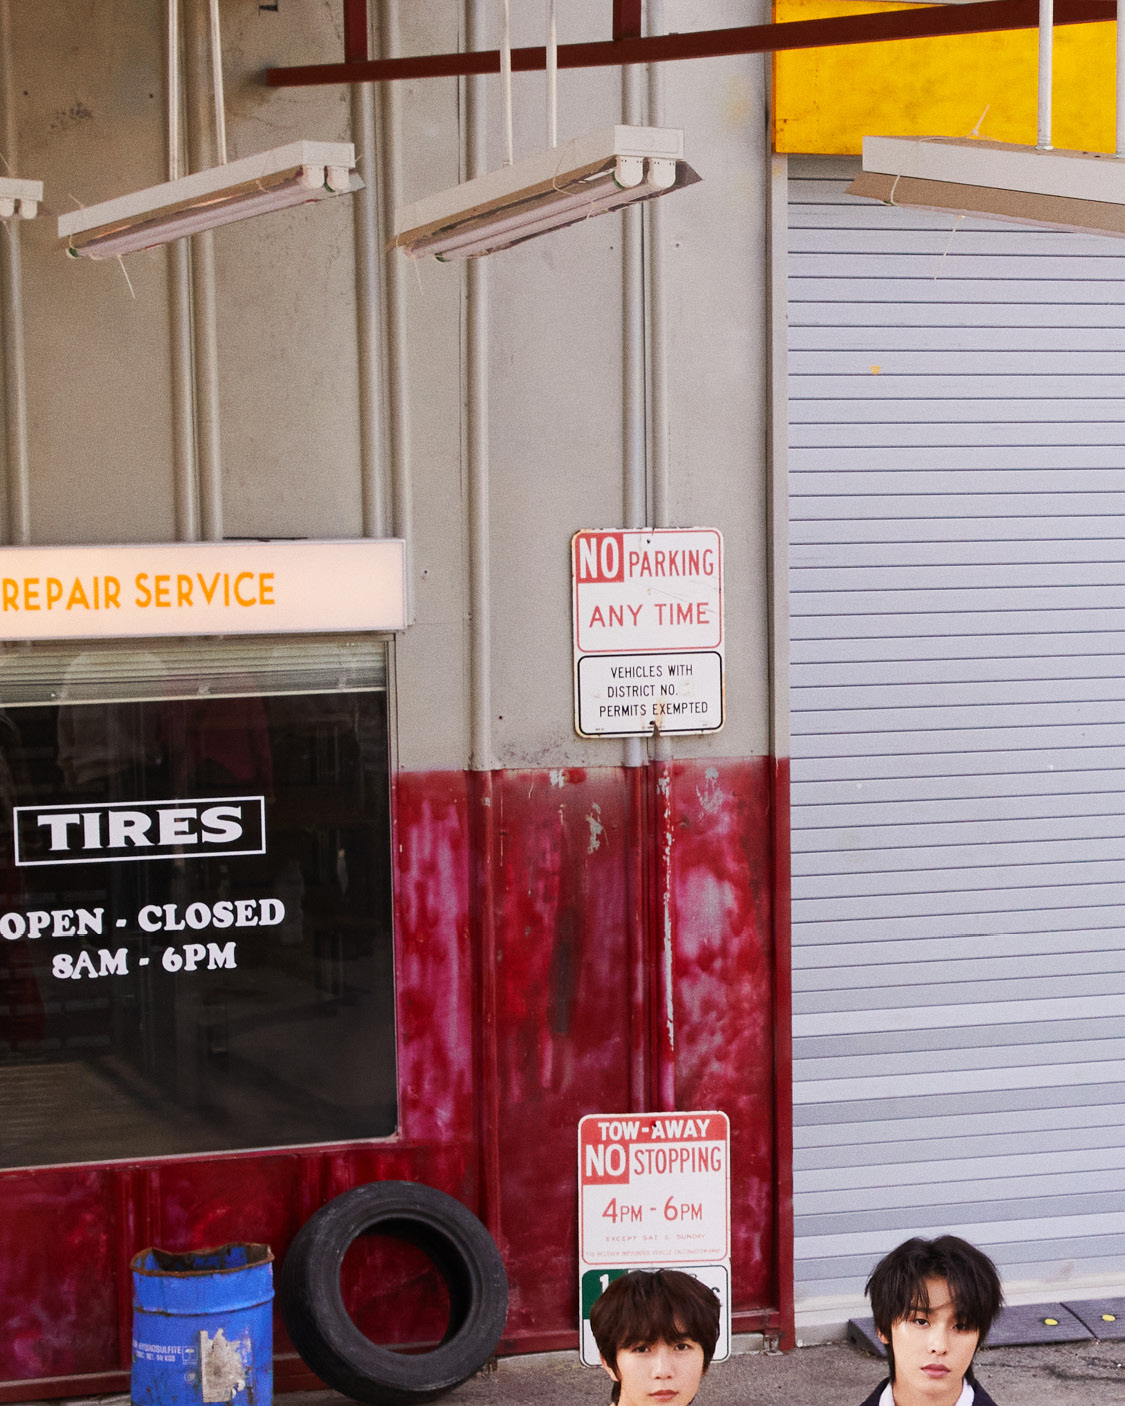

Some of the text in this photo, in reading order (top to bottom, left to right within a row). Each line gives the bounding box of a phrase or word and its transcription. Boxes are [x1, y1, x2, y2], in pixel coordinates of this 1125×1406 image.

[578, 536, 715, 579] NO PARKING
[2, 571, 276, 612] REPAIR SERVICE
[588, 602, 710, 628] ANY TIME
[610, 664, 693, 679] VEHICLES WITH
[607, 683, 679, 698] DISTRICT NO.
[599, 701, 708, 718] PERMITS EXEMPTED
[37, 805, 243, 851] TIRES
[0, 907, 104, 940] OPEN
[137, 898, 286, 932] CLOSED
[52, 947, 129, 980] 8AM
[161, 941, 237, 973] 6PM
[597, 1118, 711, 1141] TOW-AWAY
[585, 1143, 722, 1178] NO STOPPING
[601, 1197, 643, 1224] 4PM
[663, 1195, 703, 1222] 6PM
